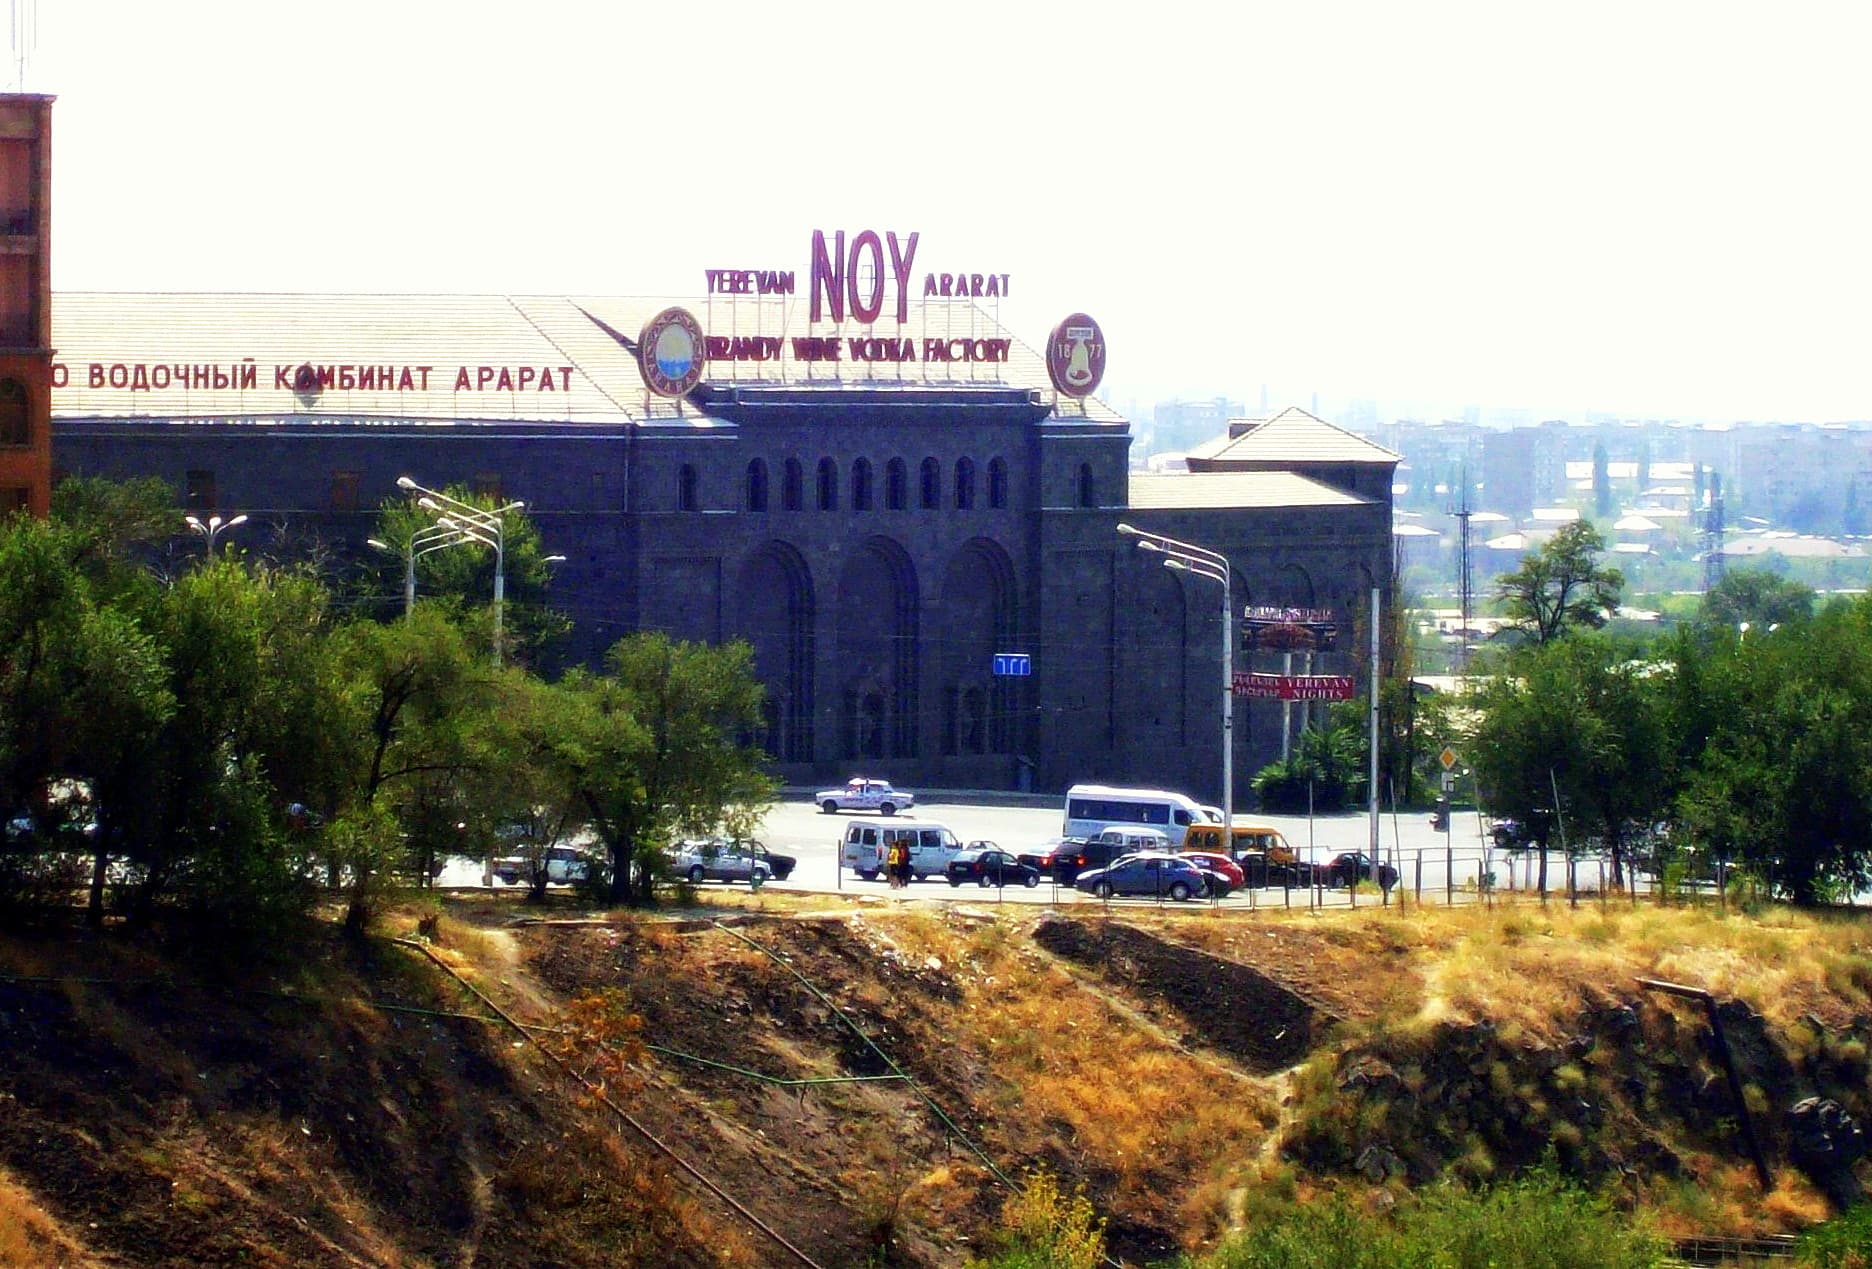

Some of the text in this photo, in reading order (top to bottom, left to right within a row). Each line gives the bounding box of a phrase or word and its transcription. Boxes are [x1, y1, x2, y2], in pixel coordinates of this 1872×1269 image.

[704, 229, 1010, 325] YEREVAN NOY ARARAT
[703, 336, 1012, 362] BRANDY WINE VODKA FACTORY
[88, 357, 257, 392] ВОДОЧНЫЙ
[273, 363, 434, 391] КОМБИНАТ
[453, 365, 575, 392] АРАРАТ
[1286, 678, 1350, 689] YEREVAN
[1292, 688, 1344, 699] NIGHTS
